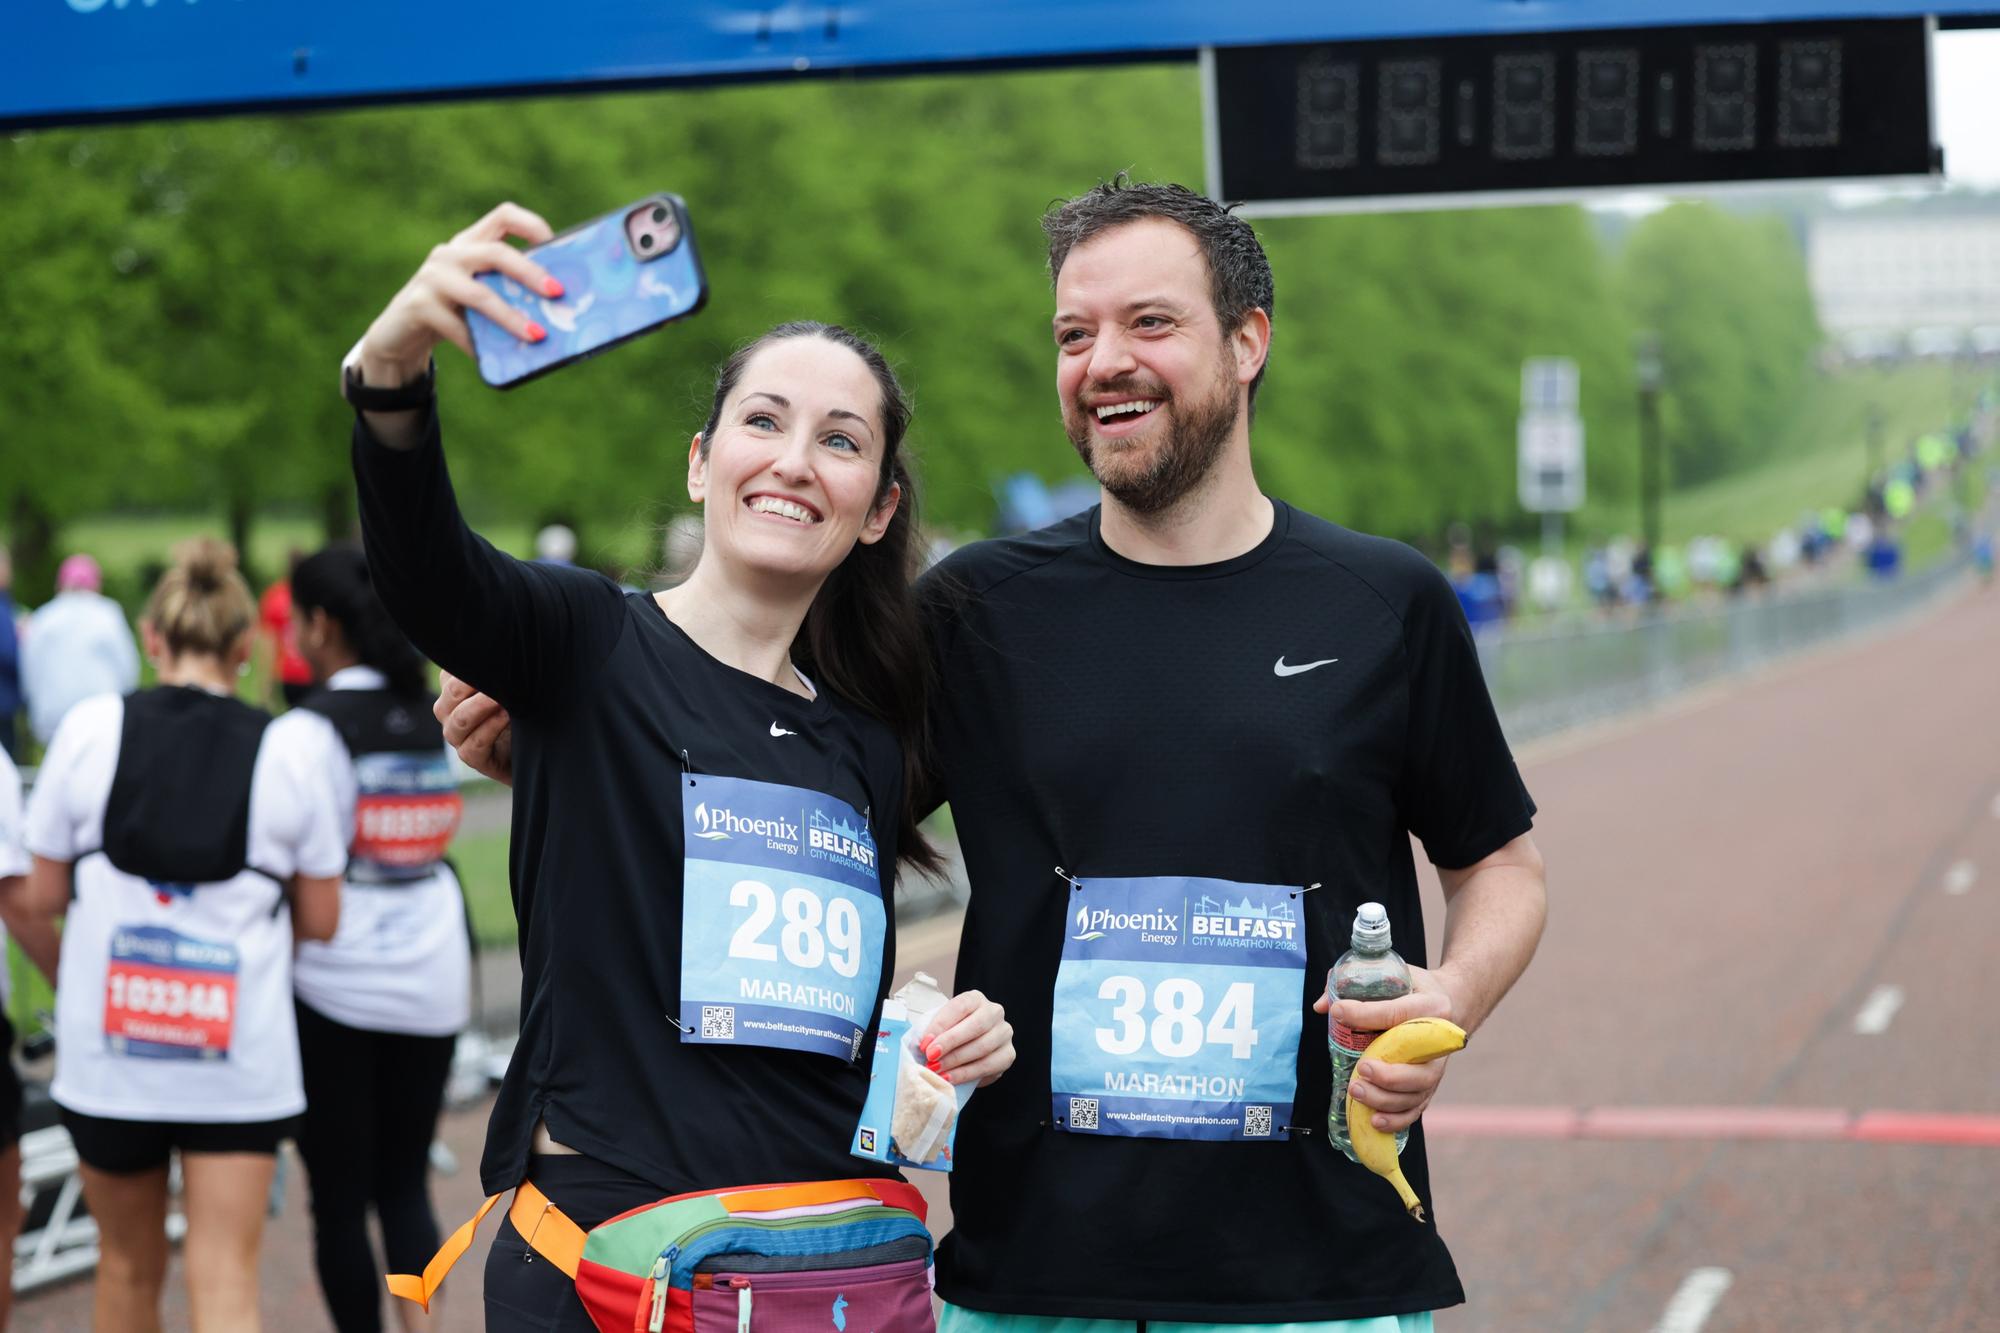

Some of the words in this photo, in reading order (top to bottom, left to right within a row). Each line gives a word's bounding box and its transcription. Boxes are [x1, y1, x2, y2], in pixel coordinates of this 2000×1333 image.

[711, 808, 798, 840] Phoenix
[766, 839, 799, 855] Energy
[809, 828, 874, 868] BELFAST
[809, 848, 828, 860] CITY
[829, 853, 865, 873] MARATHON
[728, 880, 861, 978] 289
[1089, 908, 1178, 931] Phoenix
[1192, 916, 1296, 940] BELFAST
[1141, 932, 1178, 946] Energy
[1192, 936, 1216, 946] CITY
[1217, 938, 1273, 950] MARATHON
[1275, 941, 1298, 951] 2026
[739, 977, 855, 1017] MARATHON
[1095, 975, 1258, 1060] 384
[743, 1020, 852, 1045] www.belfastcitymarathon.com
[1104, 1071, 1245, 1097] MARATHON
[1106, 1111, 1239, 1126] www.belfastcitymarathon.com
